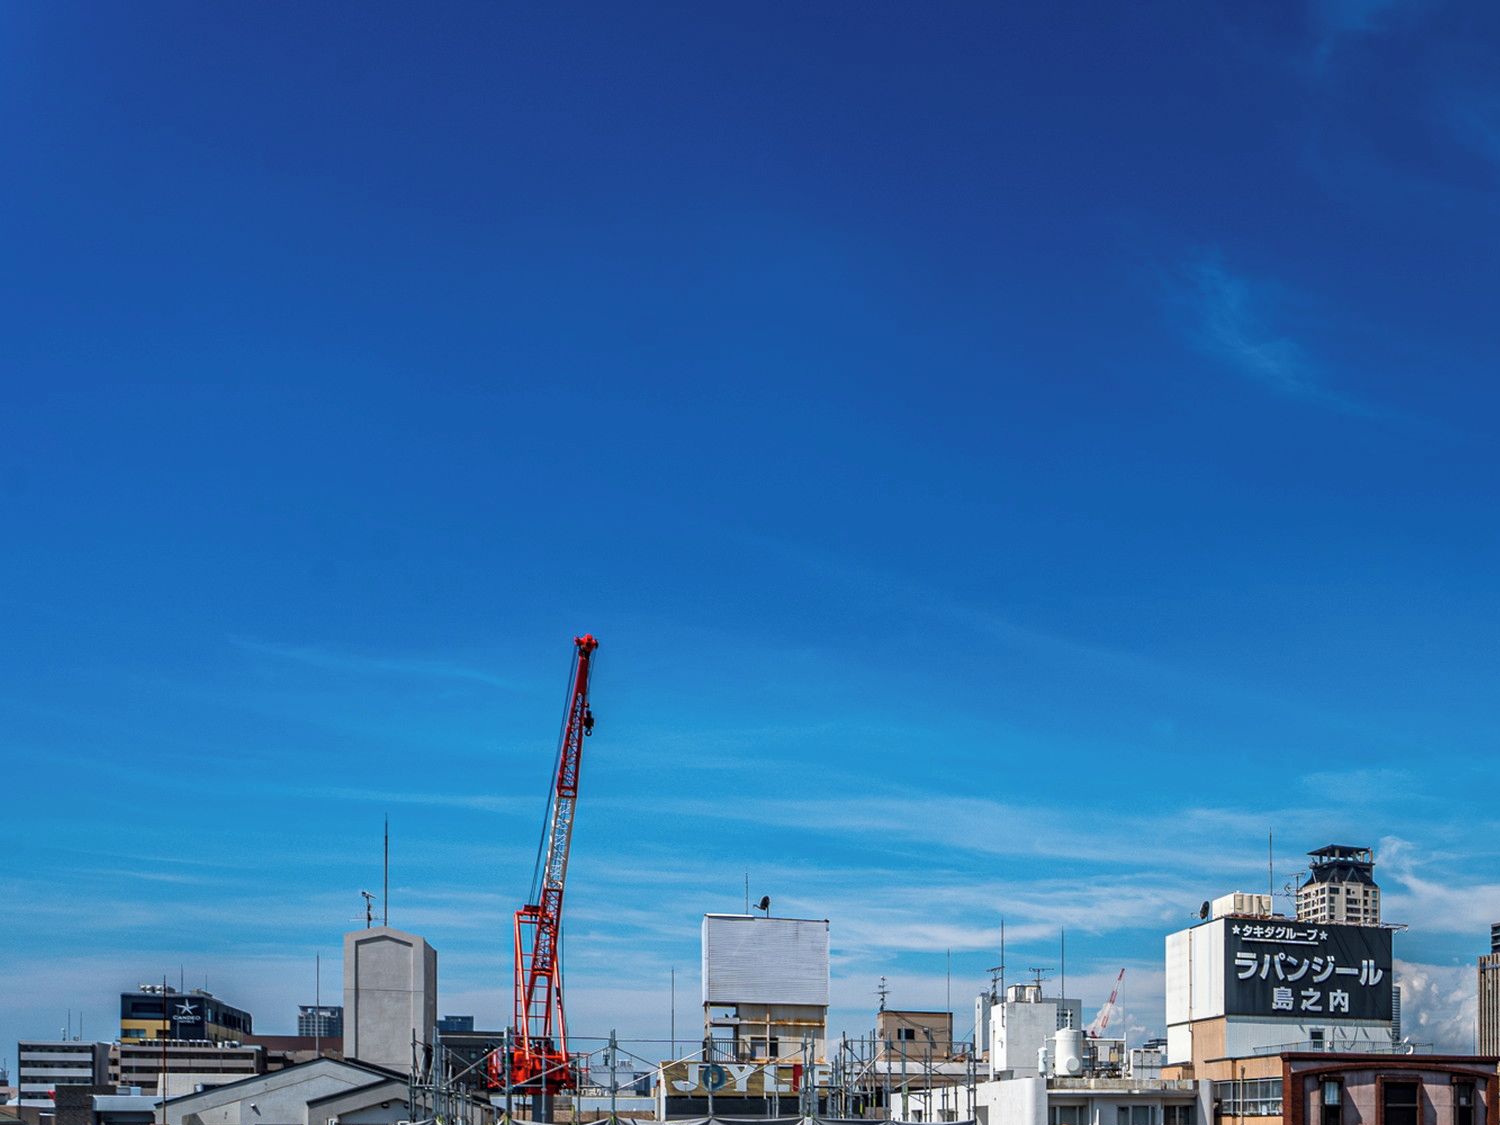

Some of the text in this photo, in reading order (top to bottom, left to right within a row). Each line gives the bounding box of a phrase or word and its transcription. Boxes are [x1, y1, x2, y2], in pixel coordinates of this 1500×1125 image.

[1242, 924, 1319, 941] タキダグループ
[1234, 951, 1384, 986] ラパンジール
[1271, 987, 1350, 1013] 島之内
